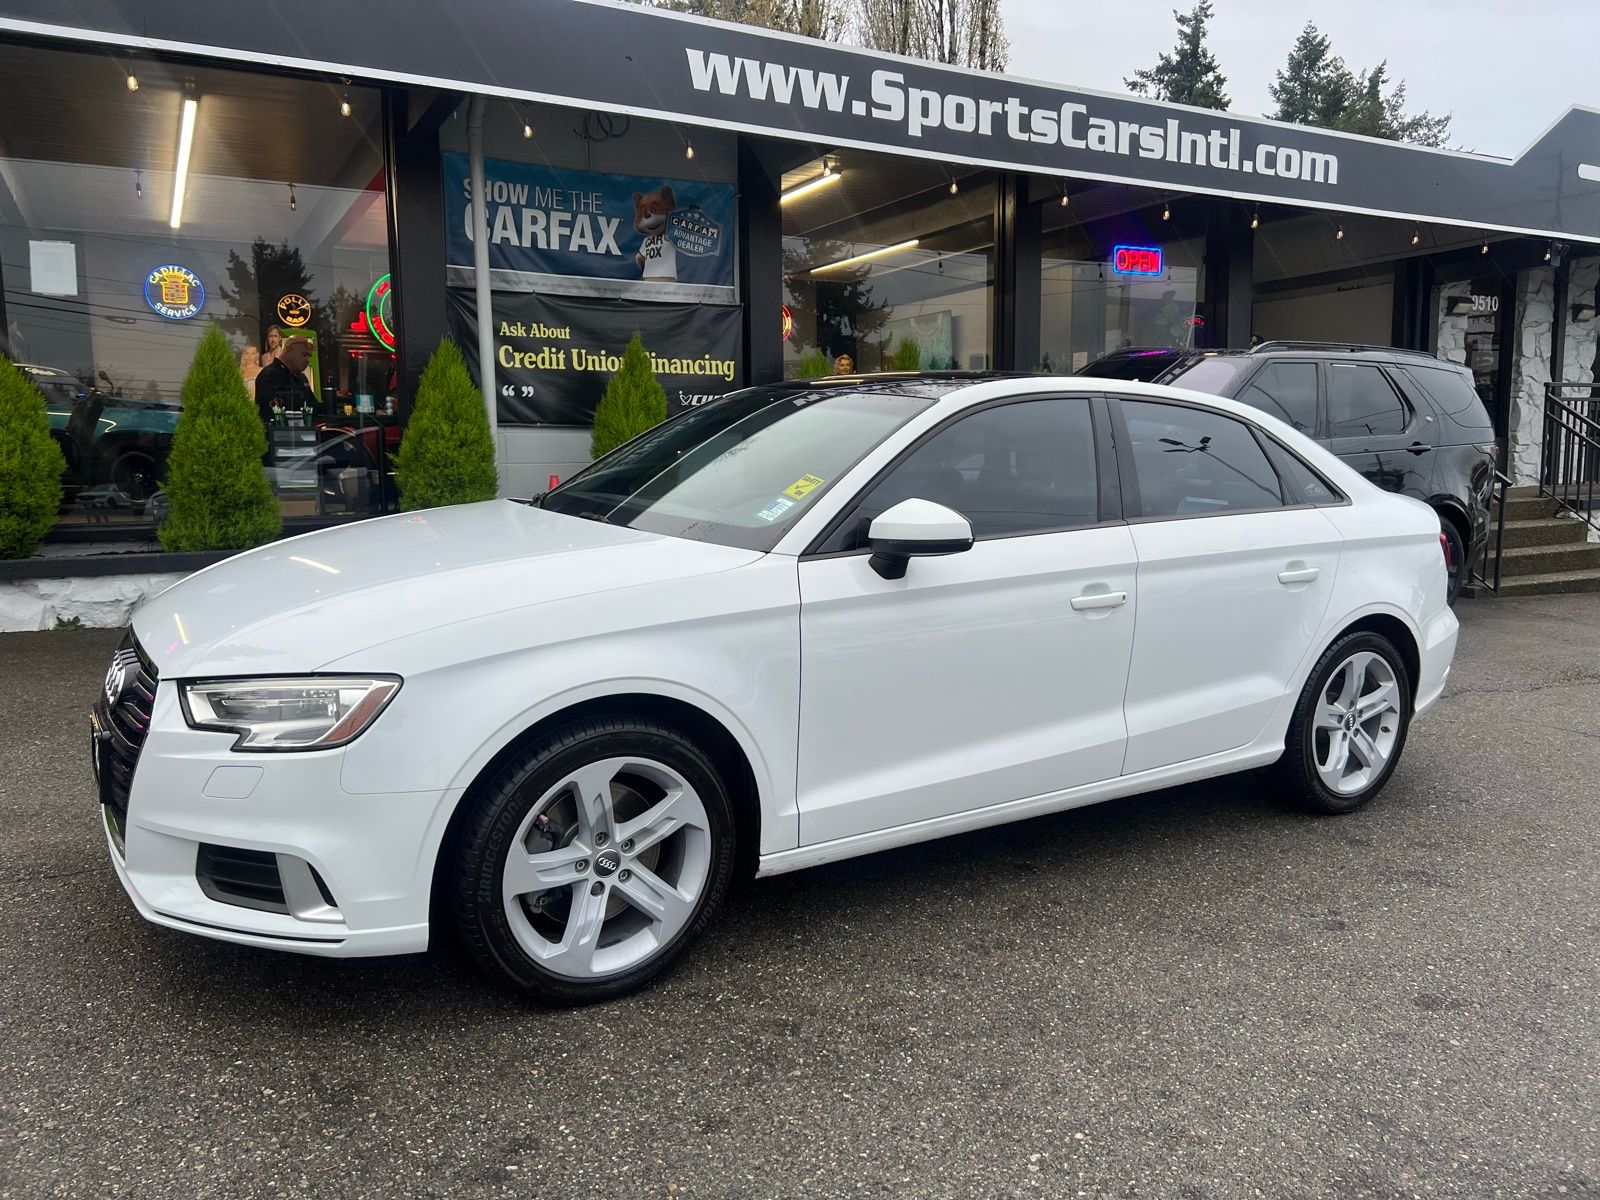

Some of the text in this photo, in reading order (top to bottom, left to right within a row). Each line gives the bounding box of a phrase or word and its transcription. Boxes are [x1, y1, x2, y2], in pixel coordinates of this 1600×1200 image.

[535, 185, 564, 210] ME
[568, 190, 603, 214] THE
[672, 218, 718, 239] CARFAX
[645, 234, 663, 248] CAR
[673, 229, 712, 247] ADVANTAGE
[677, 240, 704, 254] DEALER
[645, 246, 662, 260] FOX
[1116, 249, 1160, 273] OPEN
[149, 265, 201, 287] CADILLAC
[154, 302, 197, 318] SERVICE
[499, 321, 571, 339] Ask About
[498, 344, 566, 370] Credit
[644, 351, 735, 382] inancing
